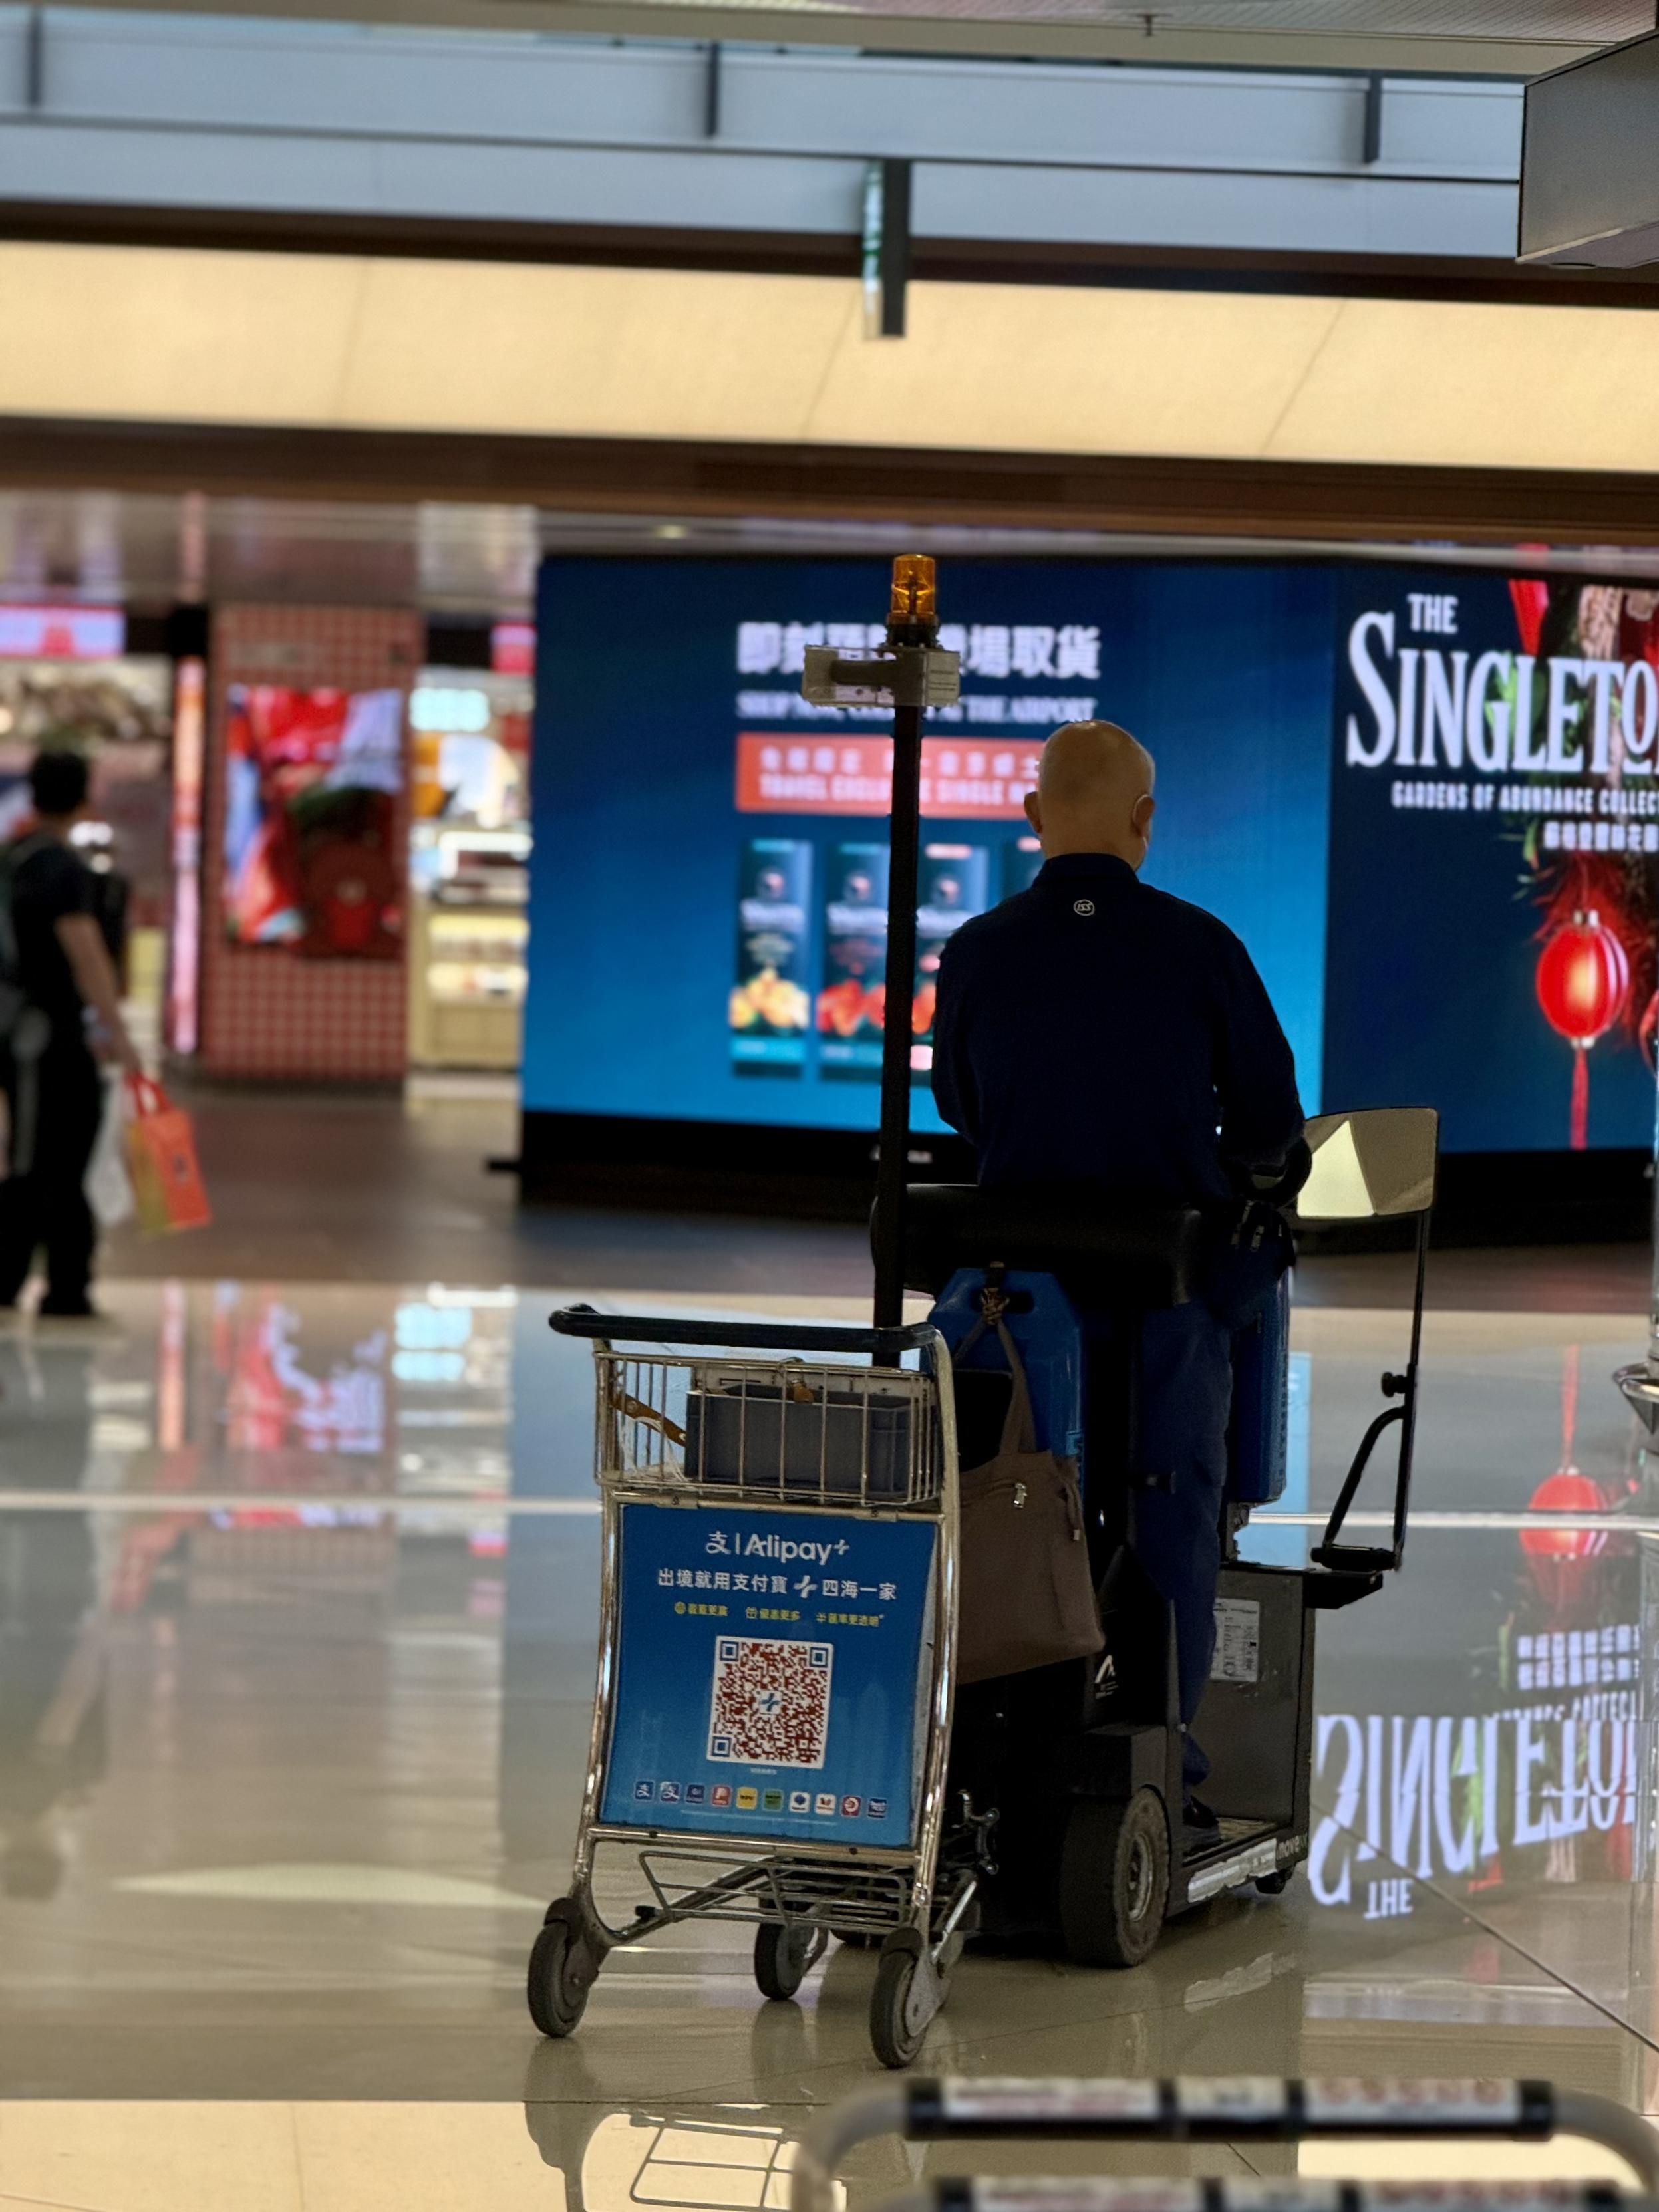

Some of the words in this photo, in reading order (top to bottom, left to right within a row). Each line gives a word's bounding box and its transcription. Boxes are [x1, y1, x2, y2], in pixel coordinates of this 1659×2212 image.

[1407, 593, 1458, 634] THE
[1346, 611, 1659, 775] SINGLETO
[1392, 781, 1468, 811] GARDENS
[1472, 784, 1495, 811] OF
[1499, 785, 1594, 813] ABUNDANCE
[1598, 789, 1659, 815] COLLEC
[658, 1568, 788, 1595] 出境就用支付寶
[822, 1579, 897, 1601] 四海一家
